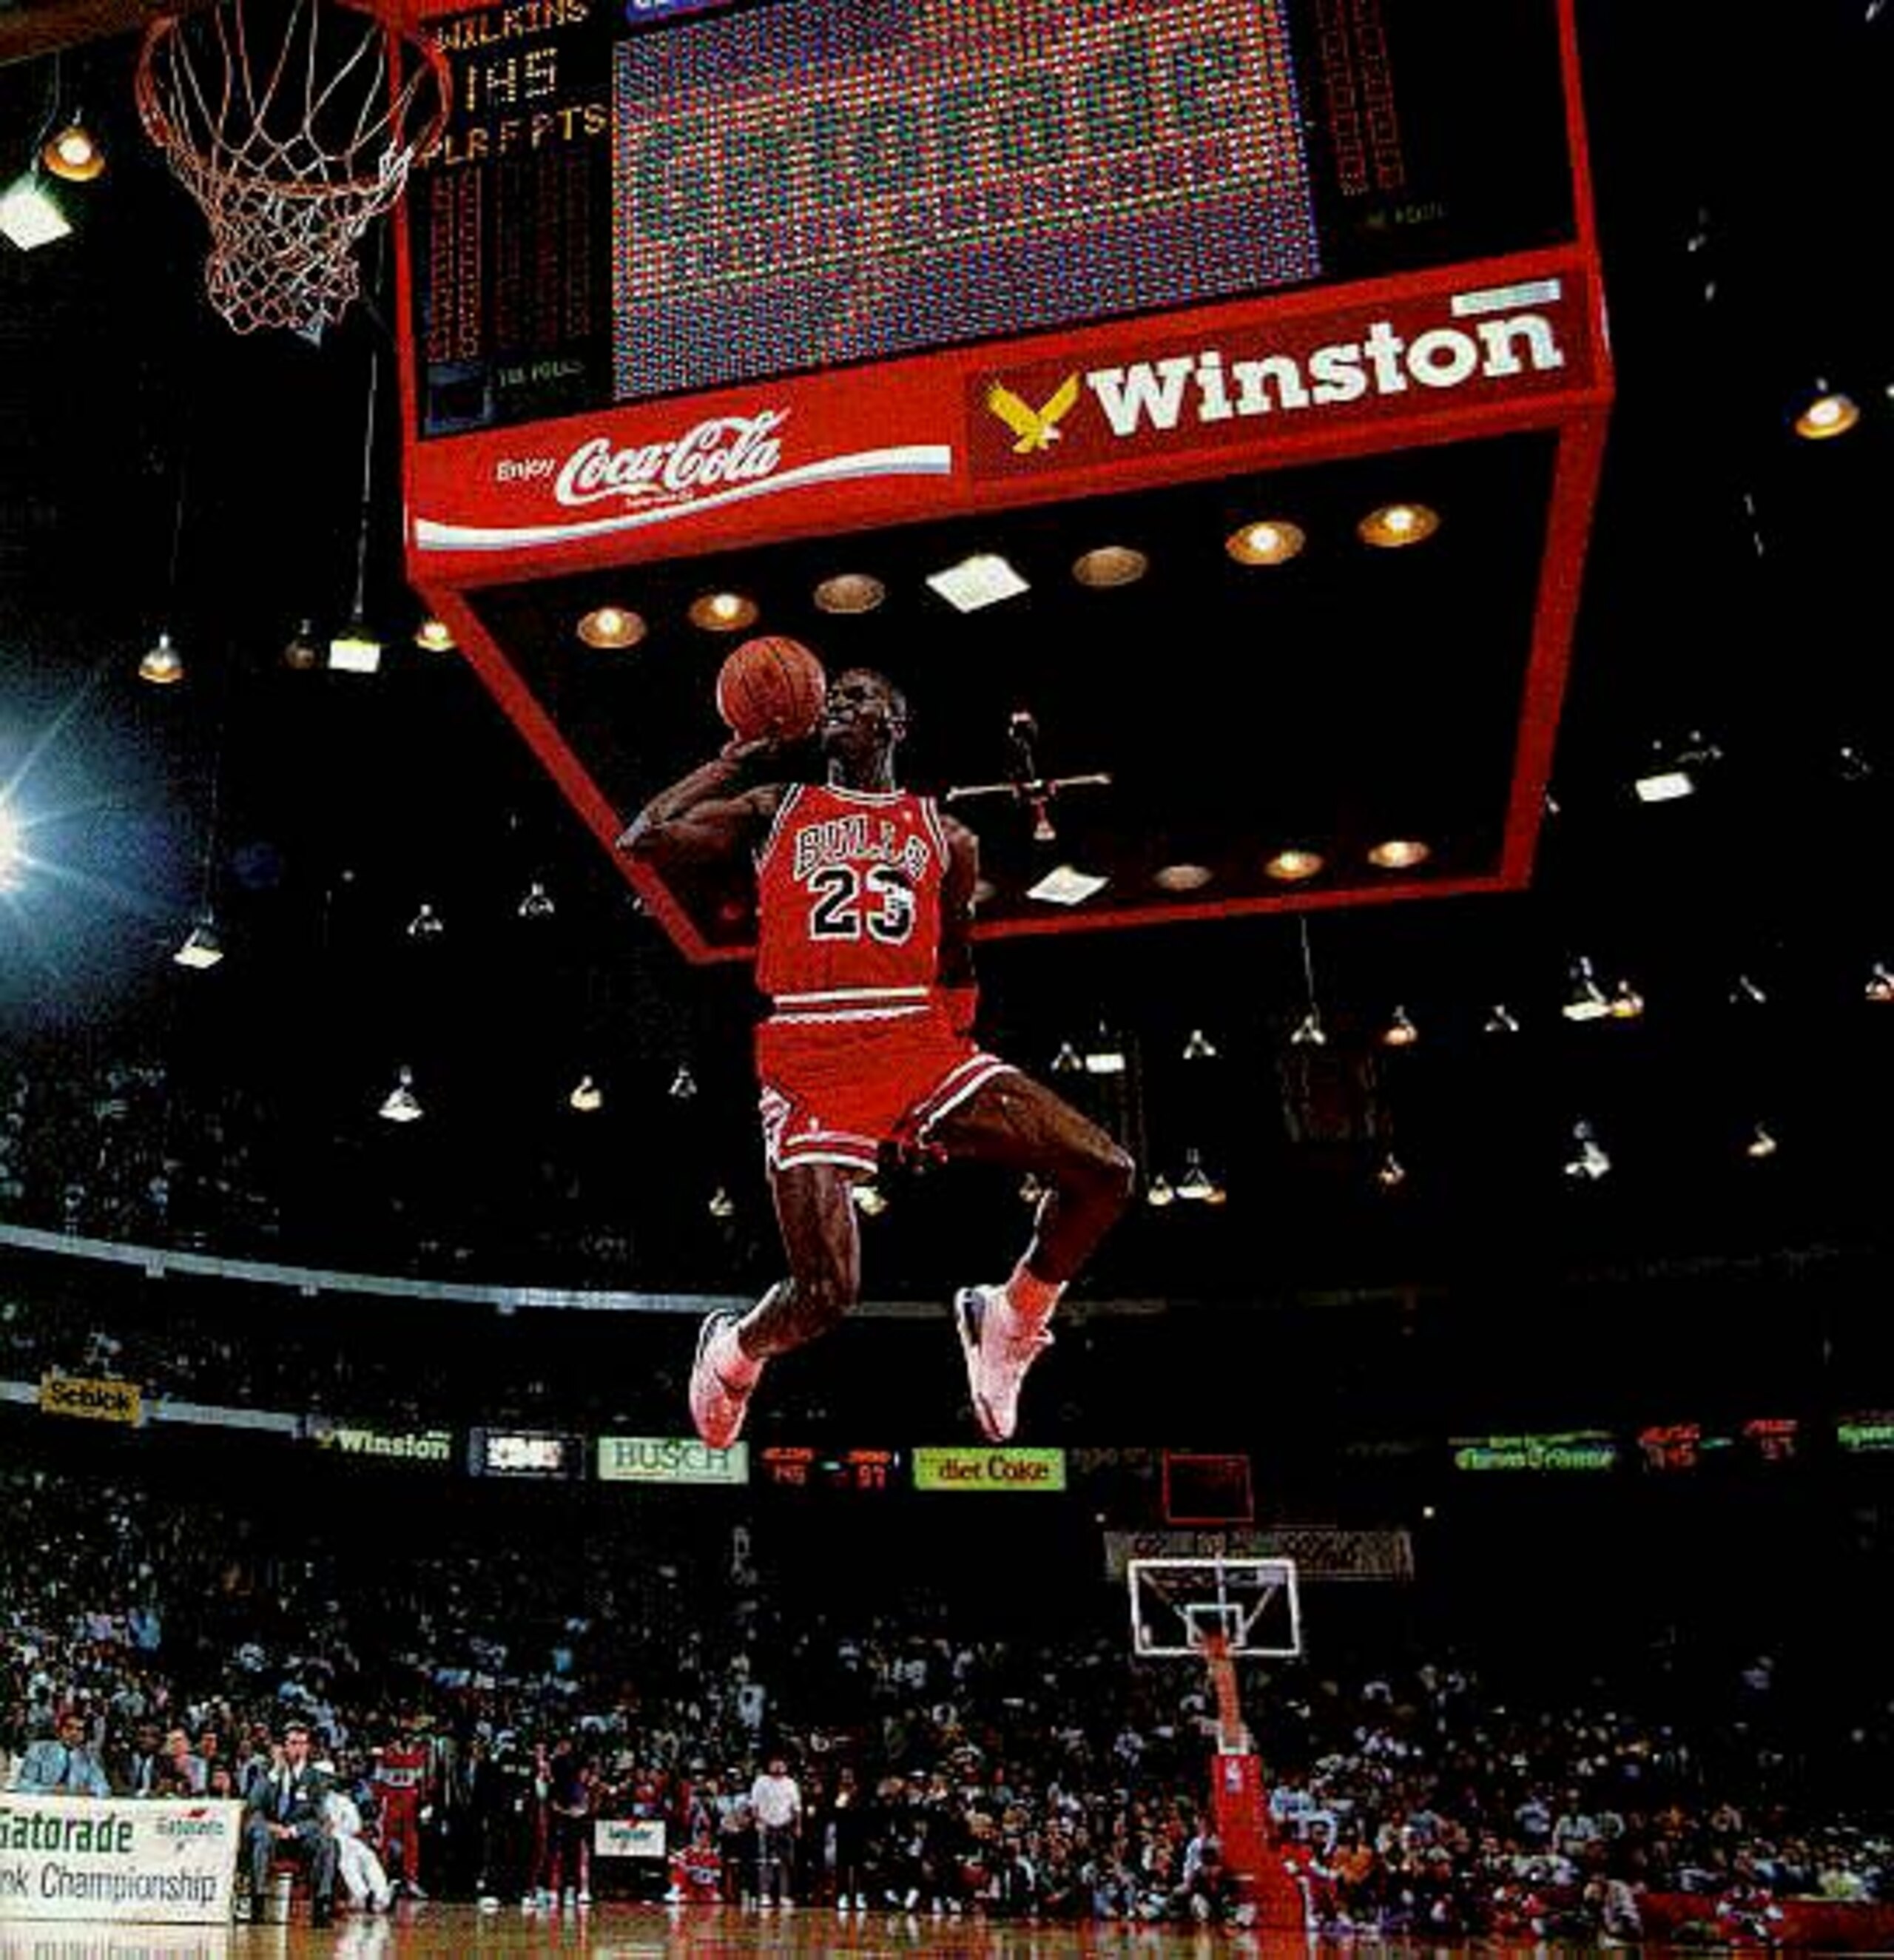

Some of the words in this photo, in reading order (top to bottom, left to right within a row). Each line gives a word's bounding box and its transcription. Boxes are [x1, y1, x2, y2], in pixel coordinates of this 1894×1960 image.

[1088, 280, 1563, 437] Winston
[496, 459, 555, 482] Enjoy
[556, 408, 792, 506] Coca-Cola
[793, 814, 929, 881] BULLS
[808, 863, 916, 946] 23
[334, 1429, 452, 1461] Winston
[988, 1455, 1050, 1482] Coke
[41, 1862, 217, 1909] Championship
